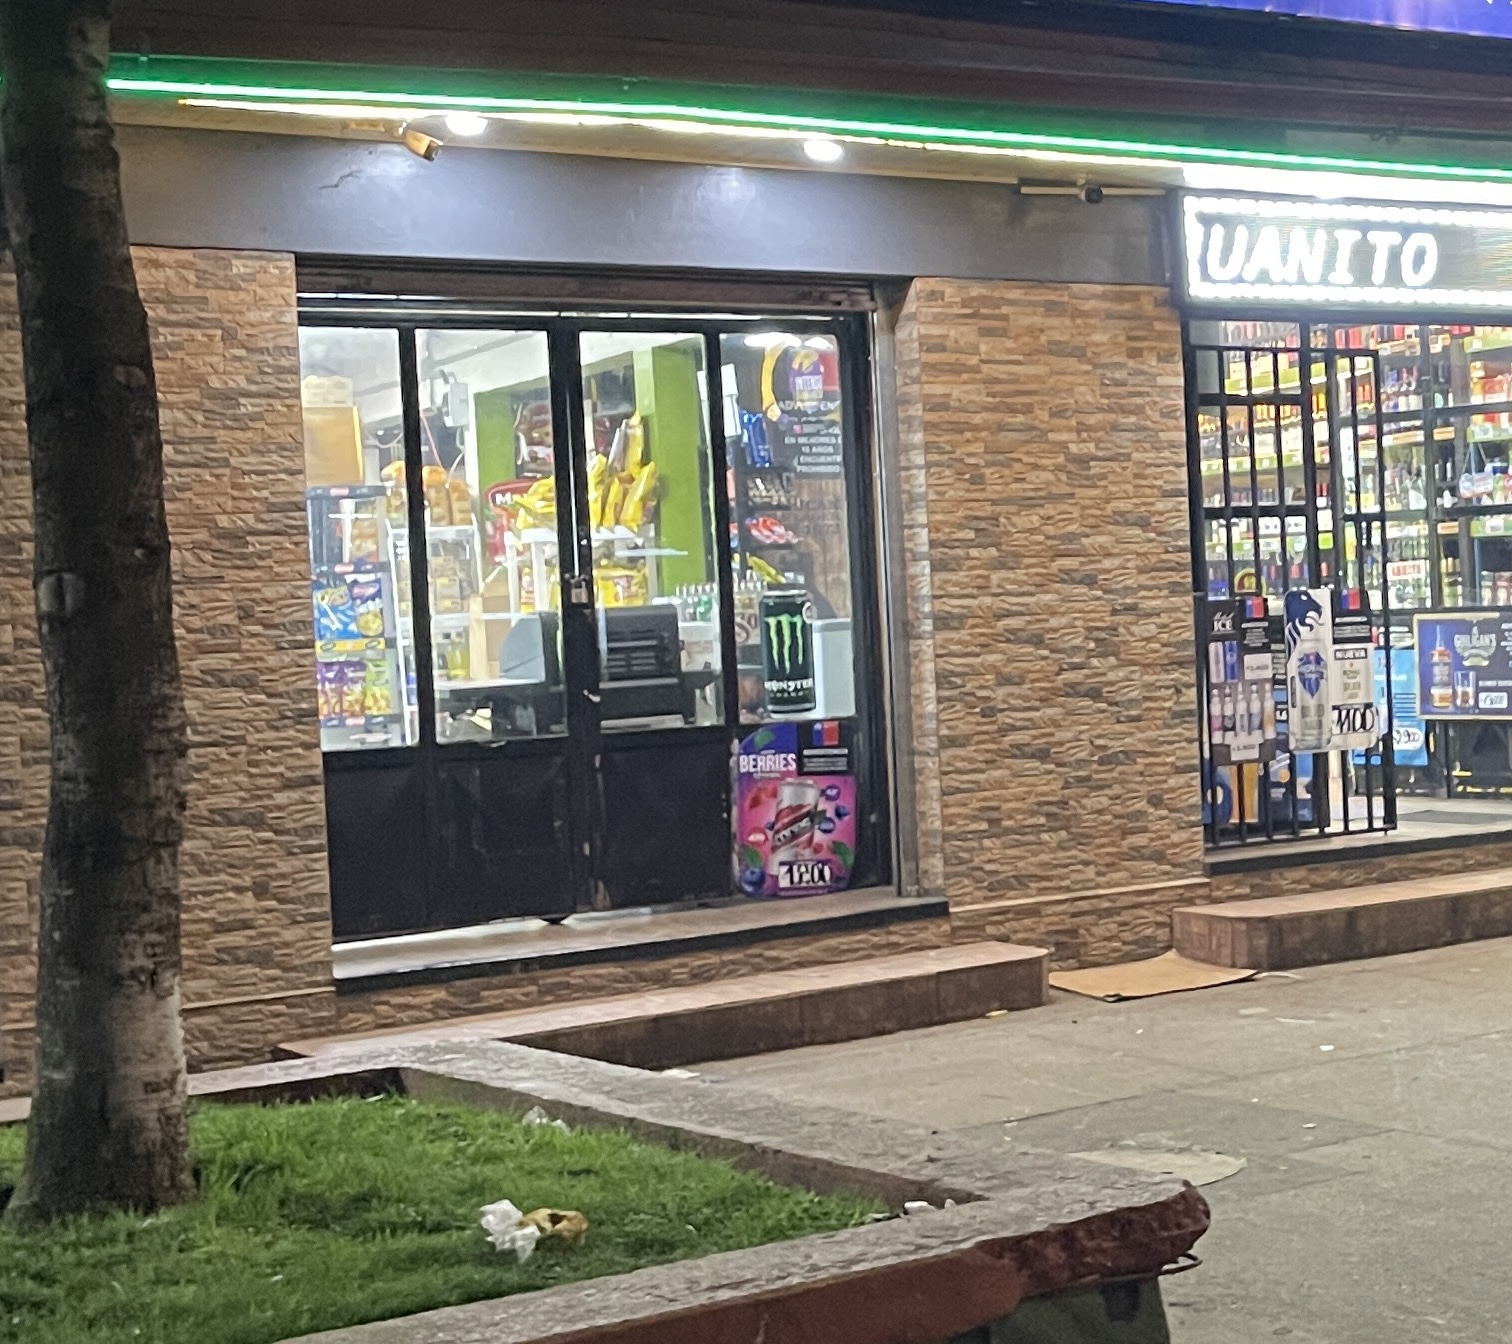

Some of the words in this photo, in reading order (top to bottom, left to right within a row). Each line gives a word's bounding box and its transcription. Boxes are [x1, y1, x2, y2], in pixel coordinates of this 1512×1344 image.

[1207, 223, 1438, 287] UANITO
[764, 677, 813, 692] MONSTER
[740, 753, 797, 773] BERRIES
